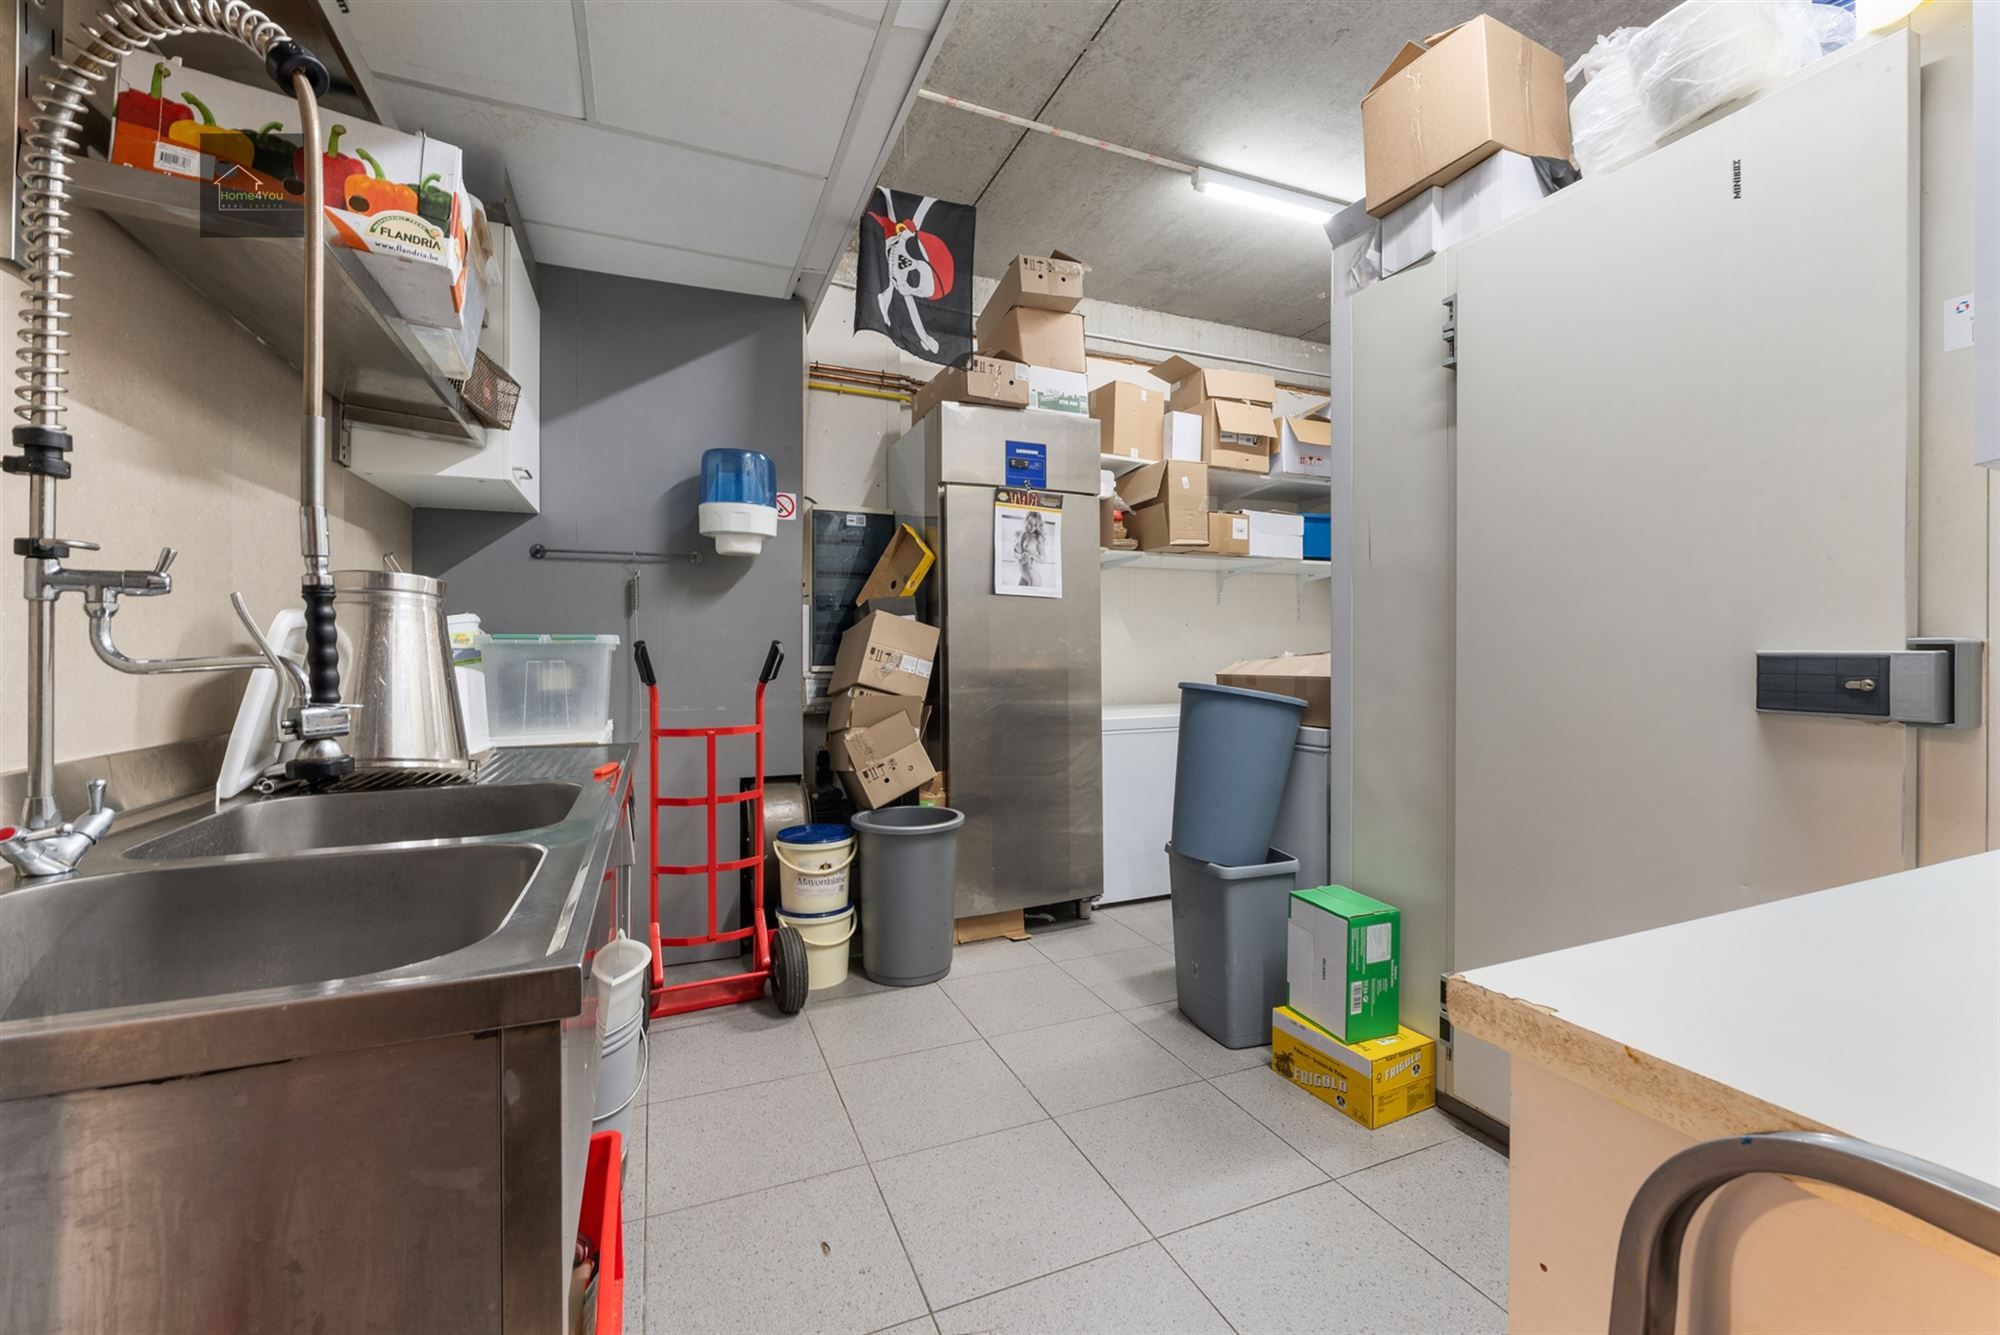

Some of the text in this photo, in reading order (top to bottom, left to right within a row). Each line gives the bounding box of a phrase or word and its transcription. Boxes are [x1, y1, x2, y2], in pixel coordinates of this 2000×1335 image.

[1732, 159, 1741, 199] MINIBOX
[374, 240, 439, 261] www.flandria.be
[380, 226, 441, 251] FLANDRIA
